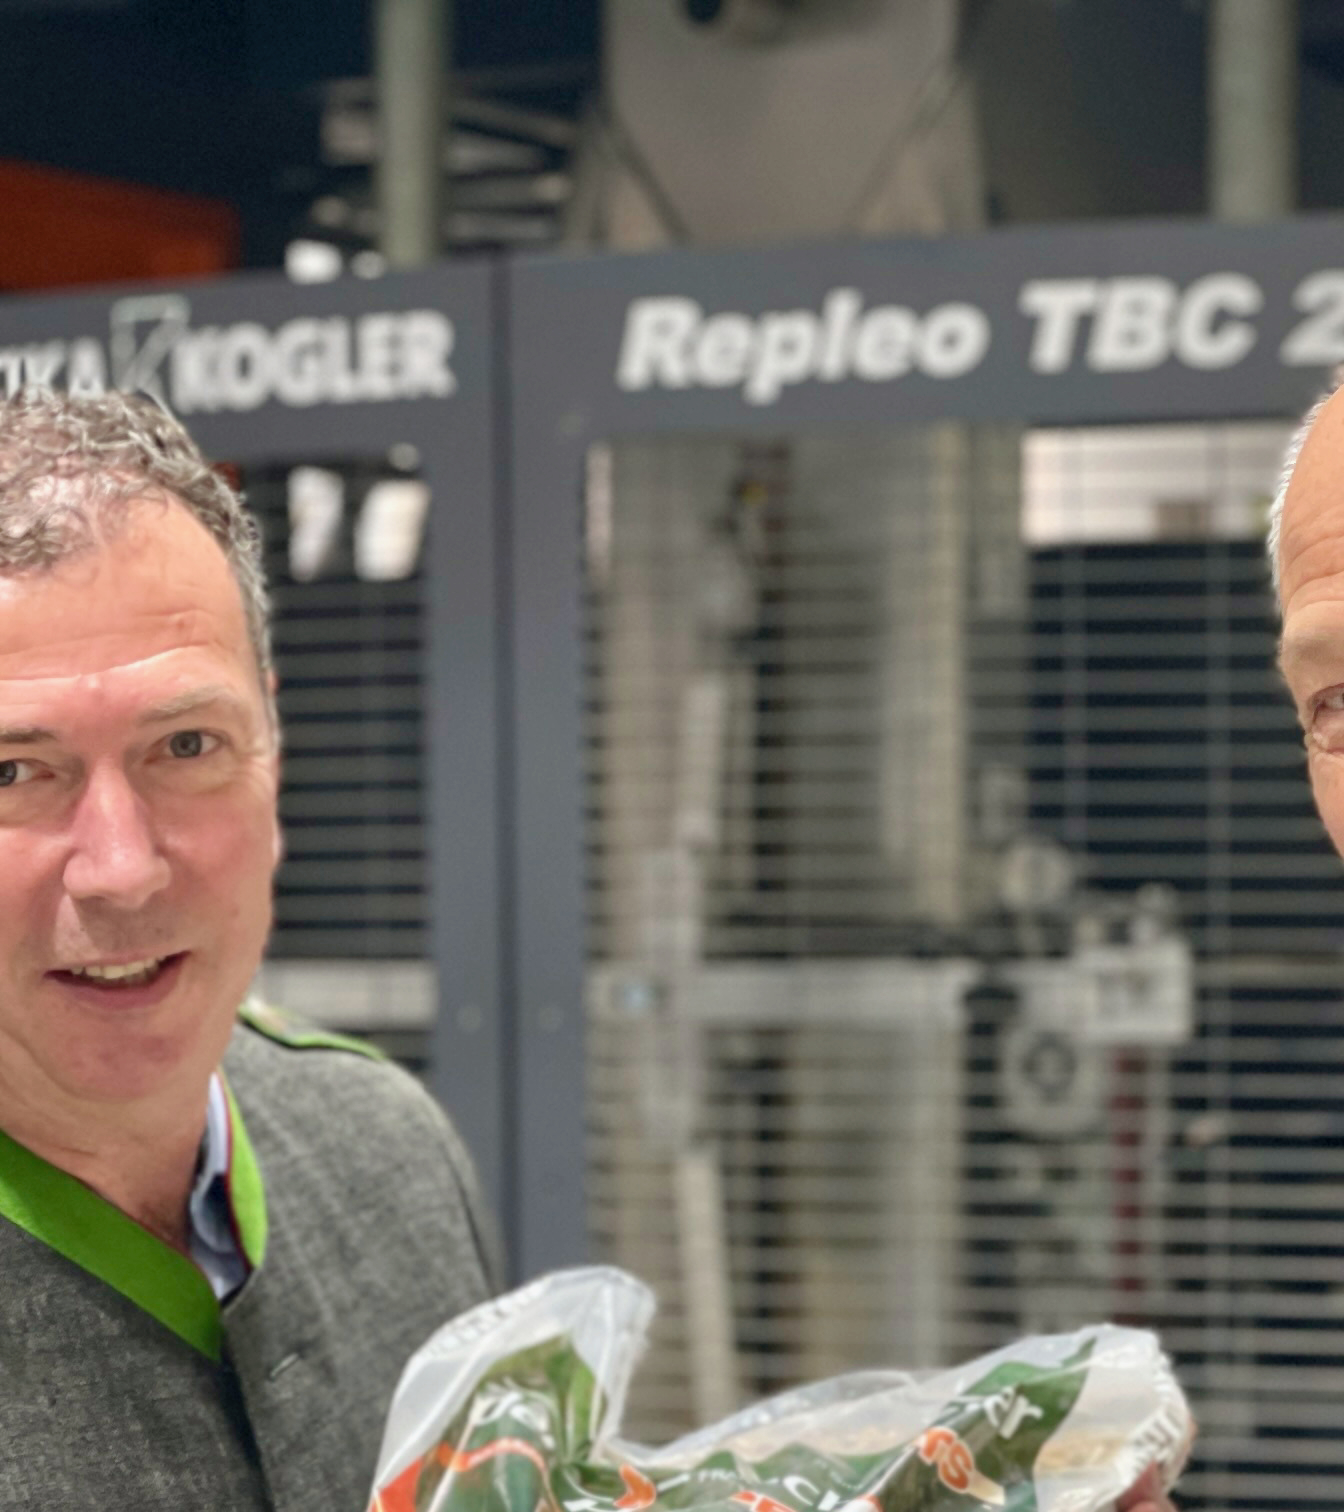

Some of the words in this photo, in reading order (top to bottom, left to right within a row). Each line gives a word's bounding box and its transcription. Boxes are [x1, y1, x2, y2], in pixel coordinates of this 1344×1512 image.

[171, 312, 454, 412] KOGLER
[618, 288, 988, 401] Repleo
[1020, 275, 1259, 372] TBC
